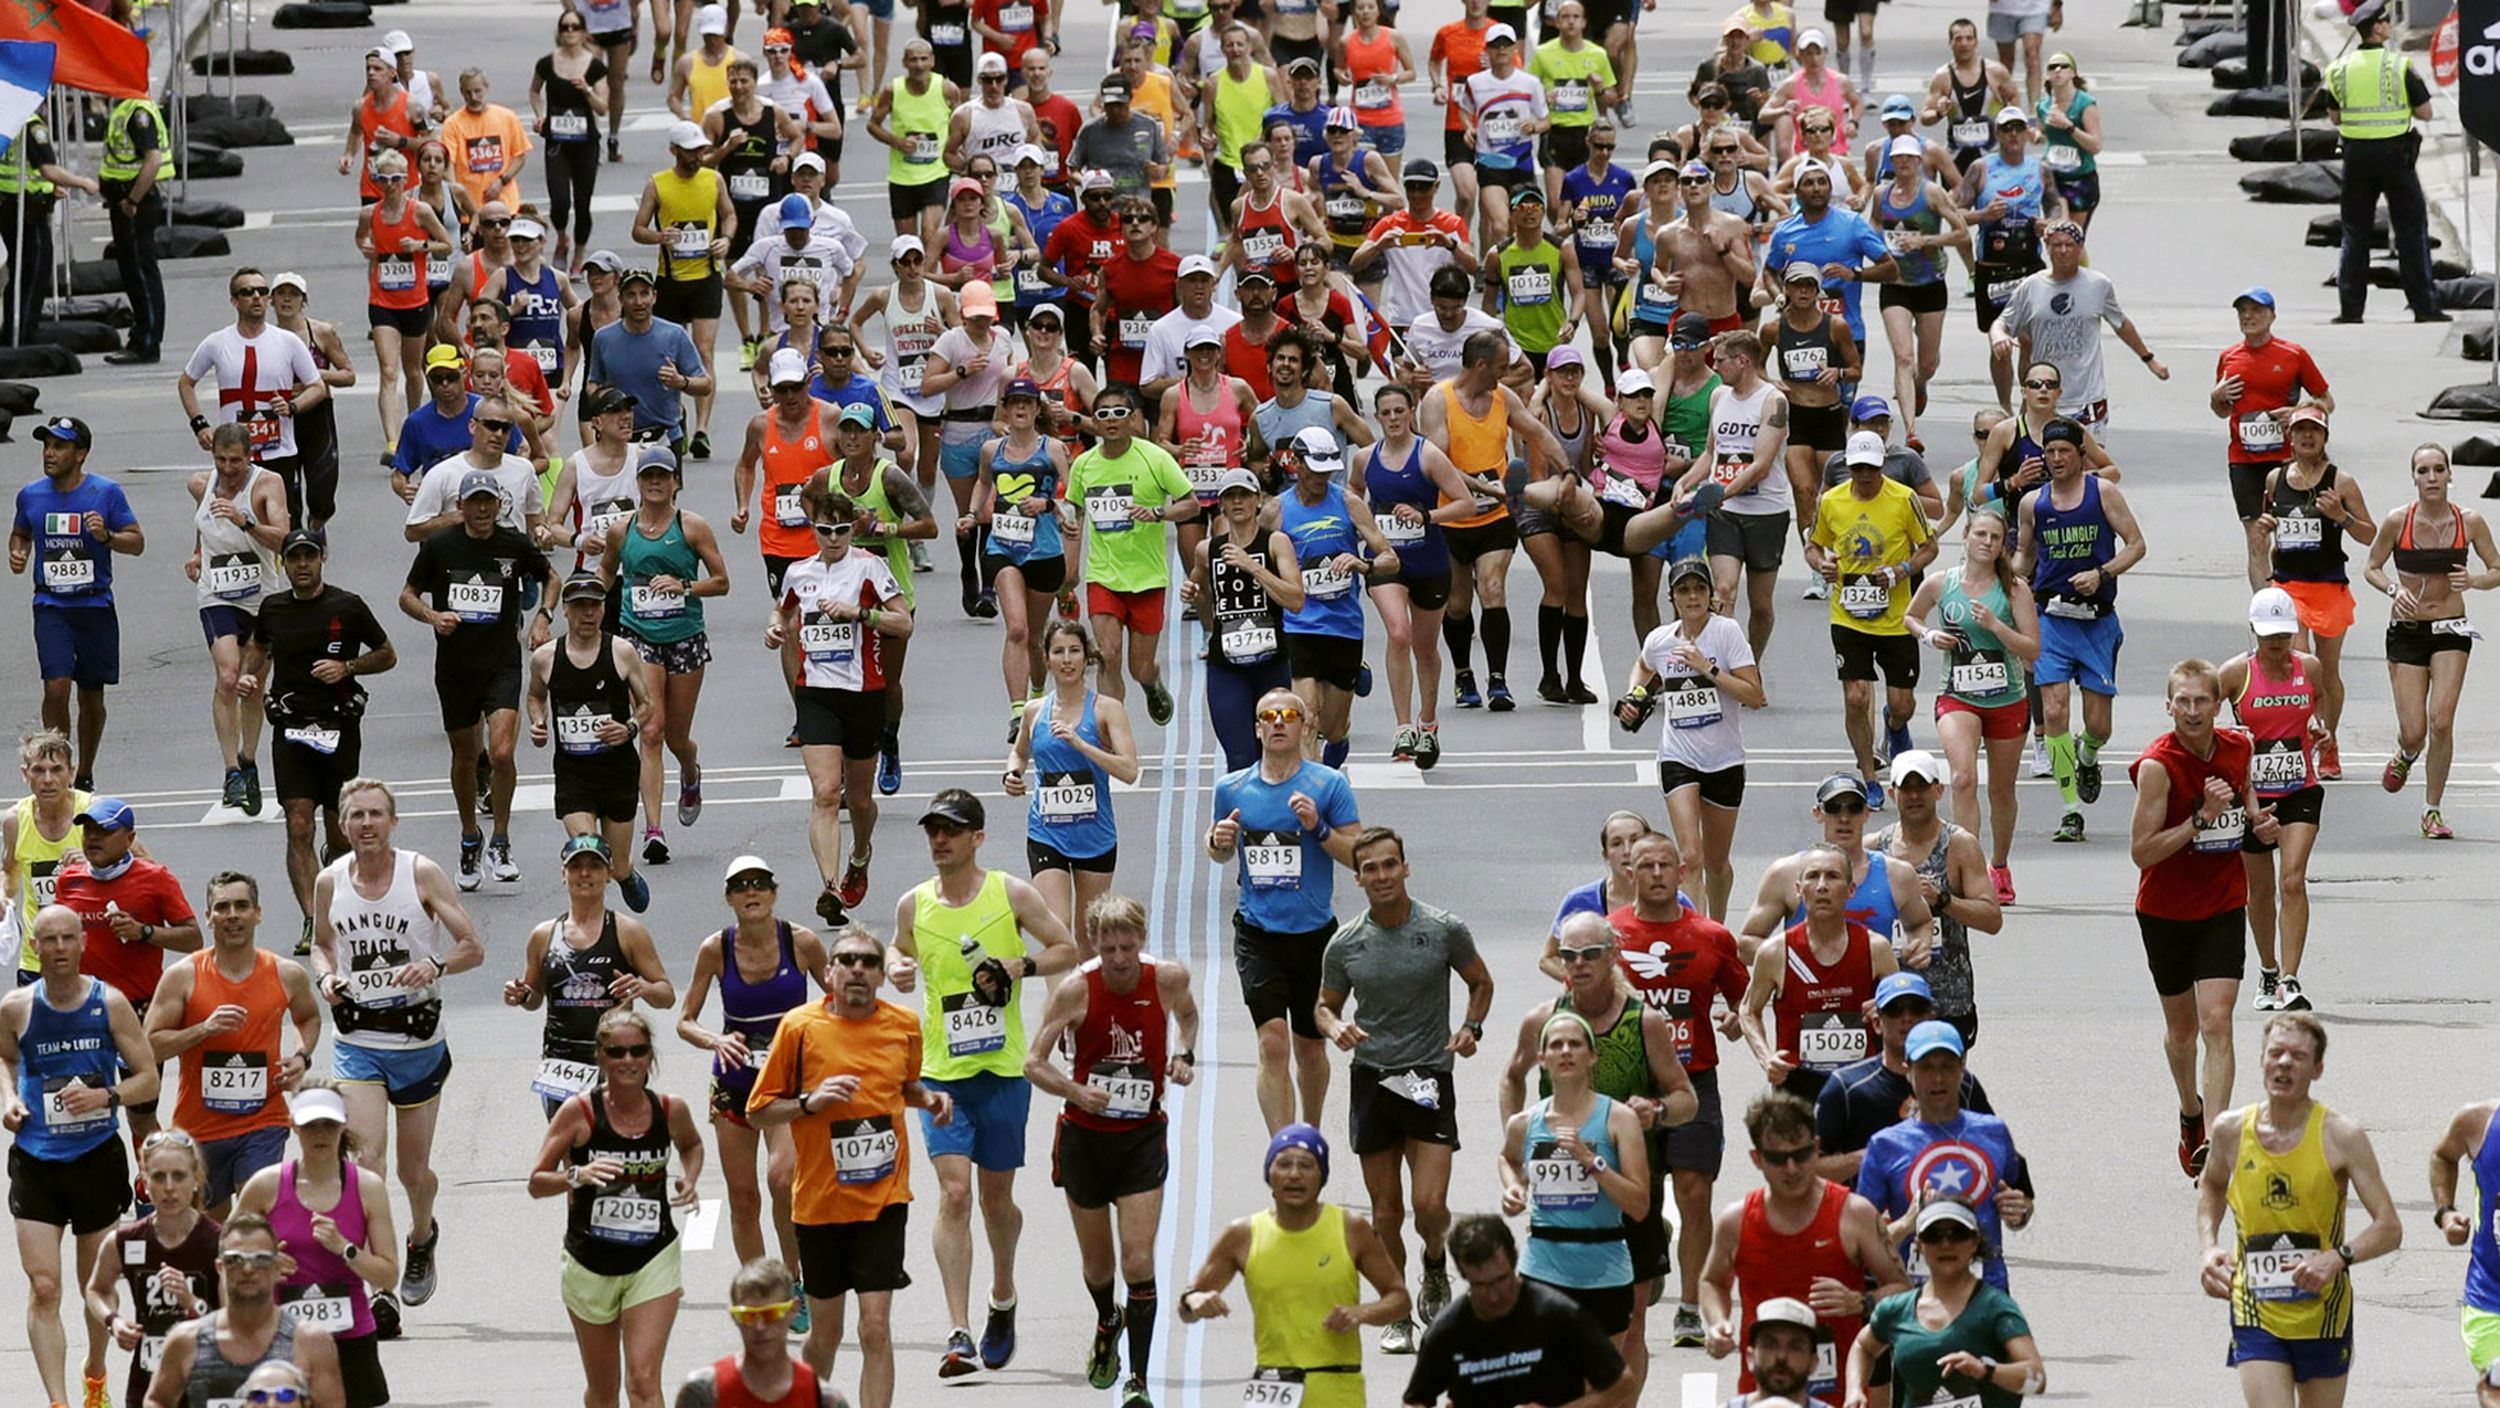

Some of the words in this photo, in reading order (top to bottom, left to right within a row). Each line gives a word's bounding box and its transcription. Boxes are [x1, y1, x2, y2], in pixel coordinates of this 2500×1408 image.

[981, 132, 1021, 150] BRC
[1245, 235, 1284, 252] 13554
[1511, 275, 1551, 290] 10125
[1786, 348, 1827, 364] 14762
[1717, 421, 1760, 438] GDTC
[2241, 422, 2284, 438] 10090
[1090, 498, 1129, 513] 9109
[995, 515, 1031, 531] 8444
[49, 563, 88, 578] 9883
[213, 566, 261, 585] 11933
[451, 587, 502, 604] 10837
[1842, 586, 1888, 603] 13248
[803, 625, 852, 643] 12548
[1224, 631, 1275, 650] 13716
[1956, 665, 2005, 684] 11543
[1669, 690, 1717, 709] 14881
[2253, 692, 2310, 709] BOSTON
[2254, 754, 2299, 770] 12794
[1041, 785, 1095, 806] 11029
[1247, 848, 1294, 866] 8815
[335, 911, 411, 937] MANGUM
[350, 937, 401, 957] TRACK
[951, 1010, 998, 1032] 8426
[36, 1042, 61, 1056] TEAM
[1802, 1031, 1866, 1051] 15028
[209, 1070, 262, 1088] 8217
[542, 1059, 598, 1083] 14647
[835, 1132, 896, 1160] 10749
[1535, 1162, 1589, 1182] 9913
[596, 1198, 659, 1220] 12055
[1458, 1354, 1507, 1376] Workout
[1507, 1348, 1544, 1368] Group
[1242, 1384, 1292, 1404] 8576
